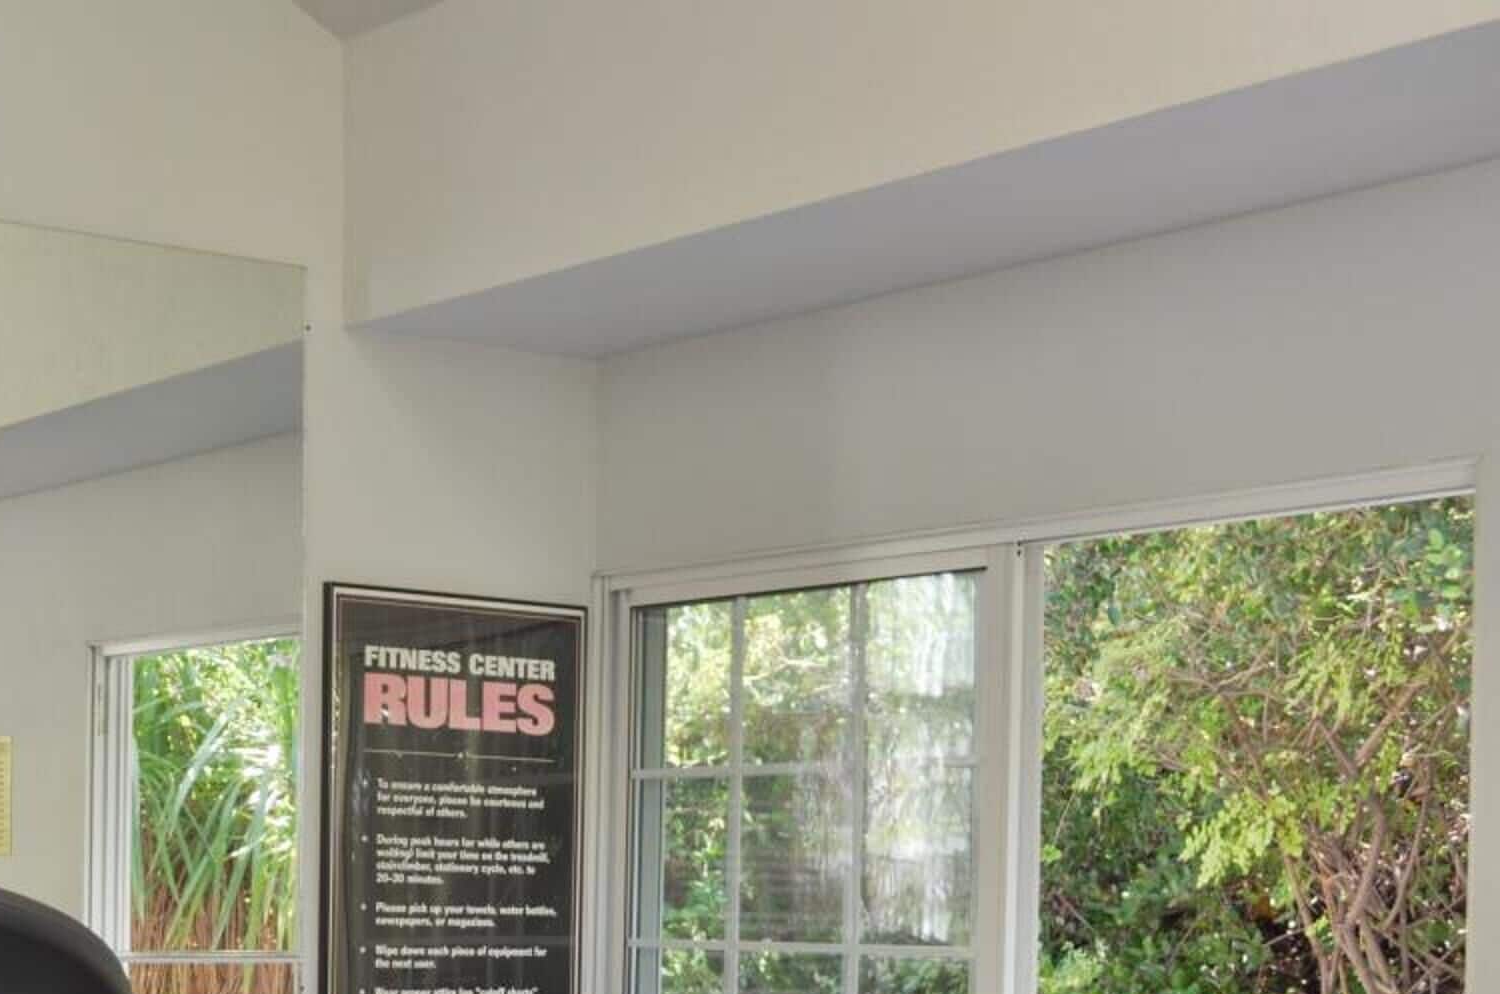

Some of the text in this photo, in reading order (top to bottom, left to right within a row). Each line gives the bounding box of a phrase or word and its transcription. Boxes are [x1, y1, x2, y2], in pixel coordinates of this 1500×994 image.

[364, 645, 555, 680] FITNESS CENTER
[363, 672, 555, 736] RULES
